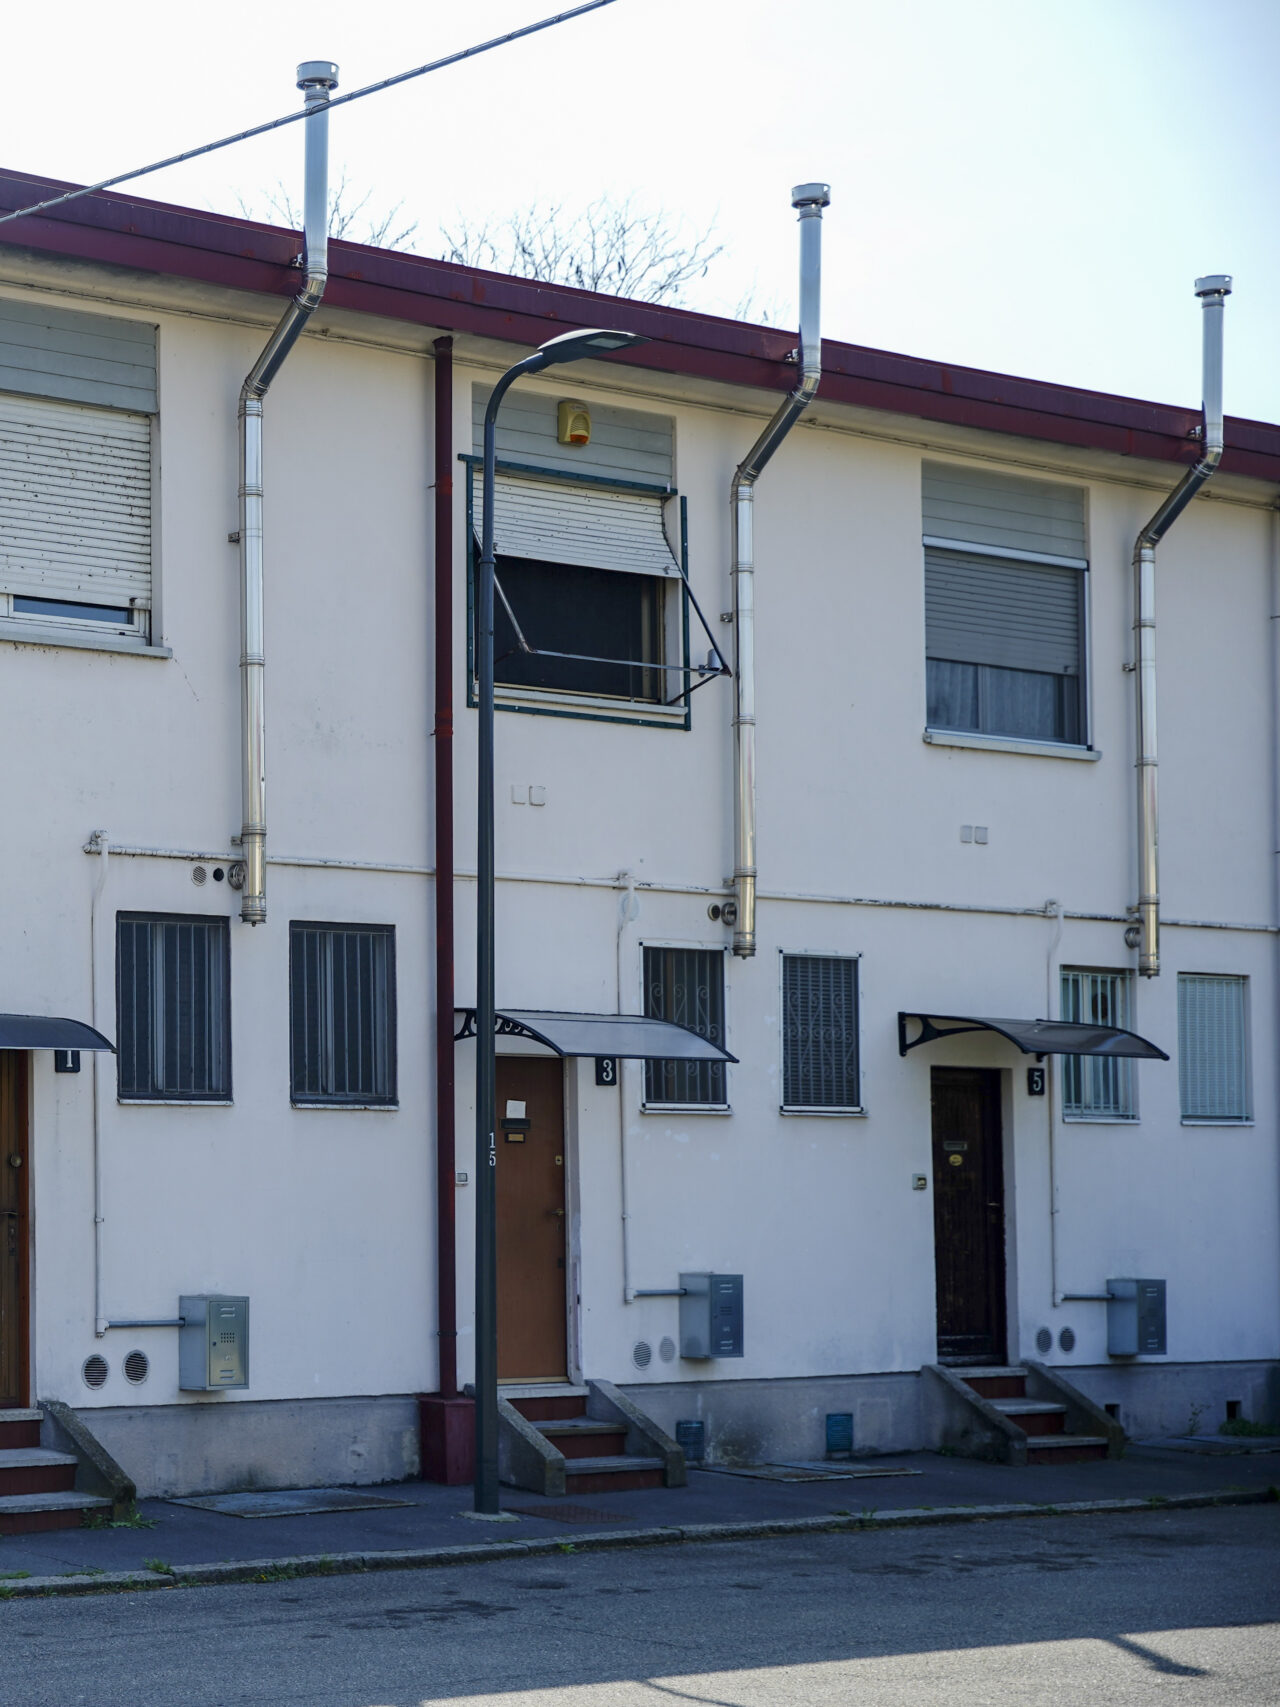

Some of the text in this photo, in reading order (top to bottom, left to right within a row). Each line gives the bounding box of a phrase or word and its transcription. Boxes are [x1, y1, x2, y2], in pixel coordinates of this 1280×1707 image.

[65, 1049, 74, 1068] 1
[602, 1058, 613, 1082] 3
[1032, 1071, 1043, 1092] 5
